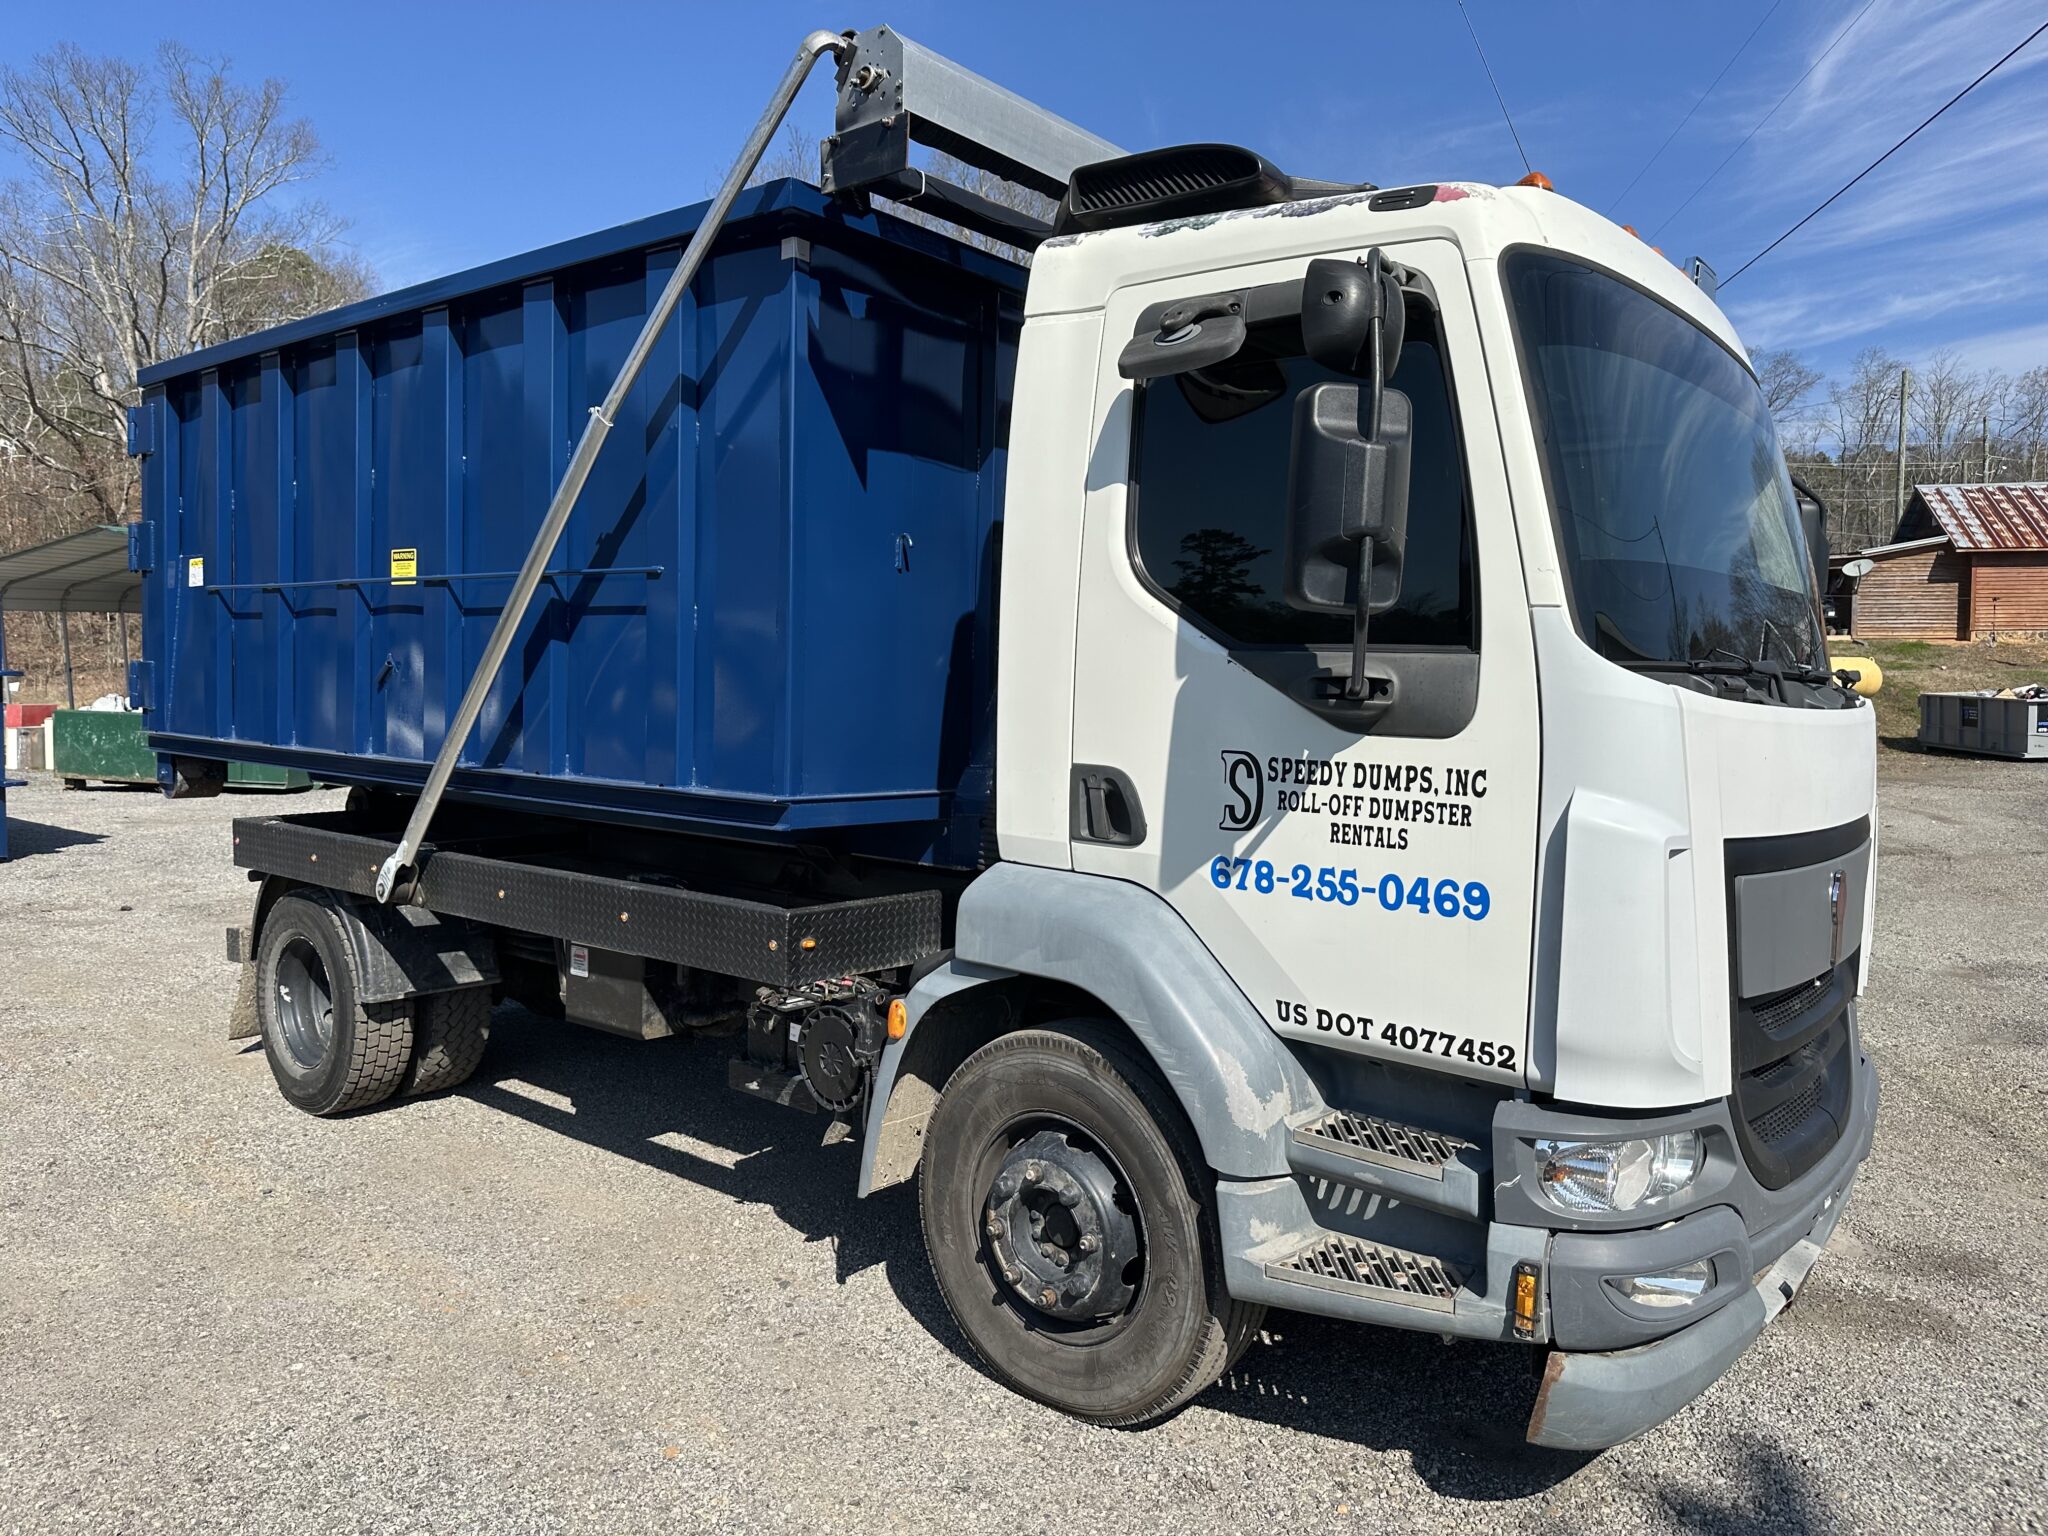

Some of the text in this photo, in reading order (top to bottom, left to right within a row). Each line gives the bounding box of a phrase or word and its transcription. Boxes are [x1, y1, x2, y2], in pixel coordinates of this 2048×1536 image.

[1267, 756, 1488, 798] SPEEDY DUMPS, INC
[1277, 789, 1472, 827] ROLL-OFF DUMPSTER
[1329, 822, 1409, 850] RENTALS
[1210, 855, 1491, 921] 678-255-0469
[1275, 999, 1517, 1073] US DOT 4077452
